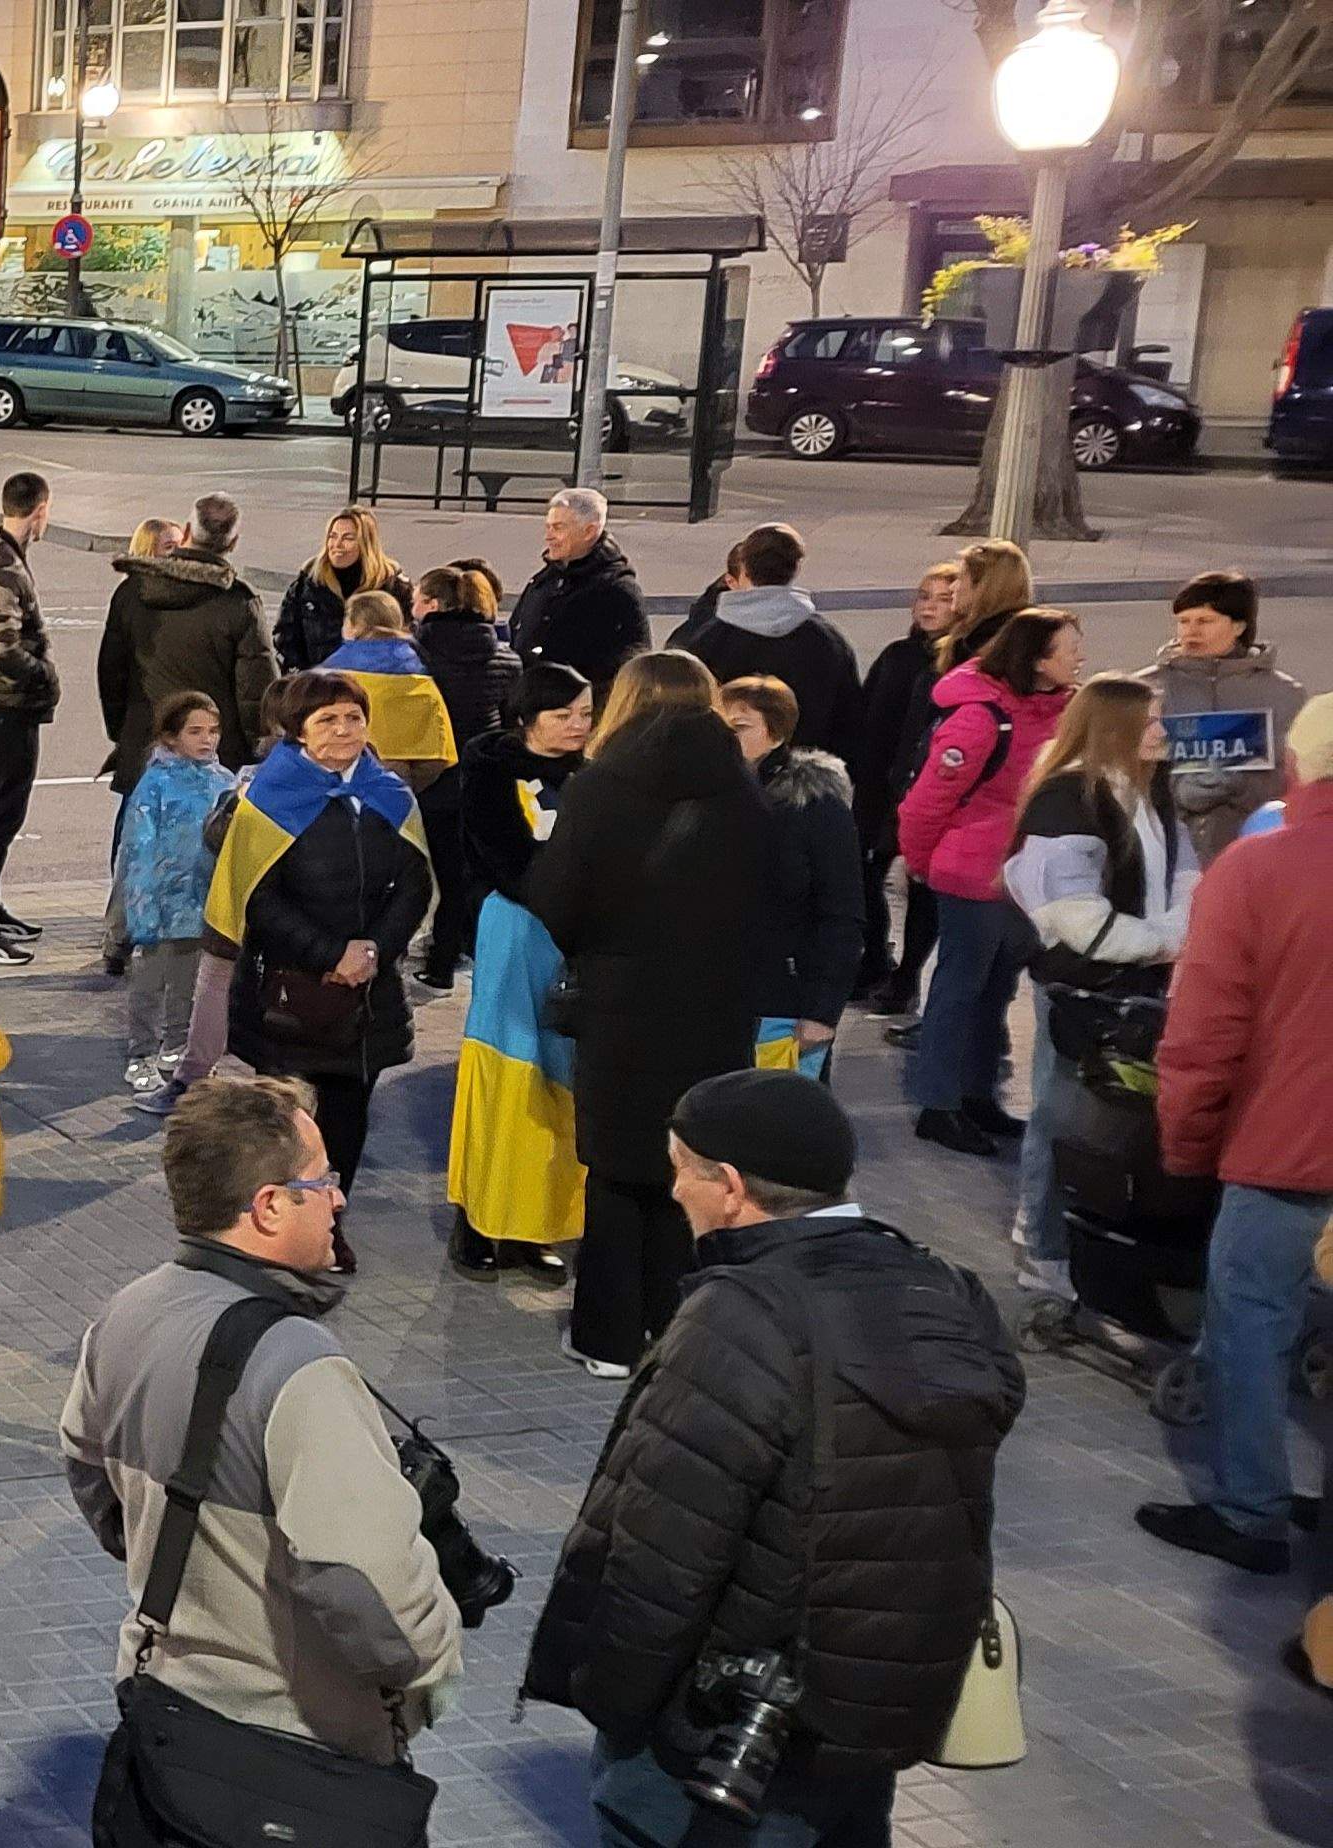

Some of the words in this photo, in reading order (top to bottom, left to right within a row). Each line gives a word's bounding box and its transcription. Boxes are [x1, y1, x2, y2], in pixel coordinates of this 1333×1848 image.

[46, 199, 134, 211] RESURANTE
[153, 197, 203, 209] GRANJA
[209, 195, 249, 208] ANITA
